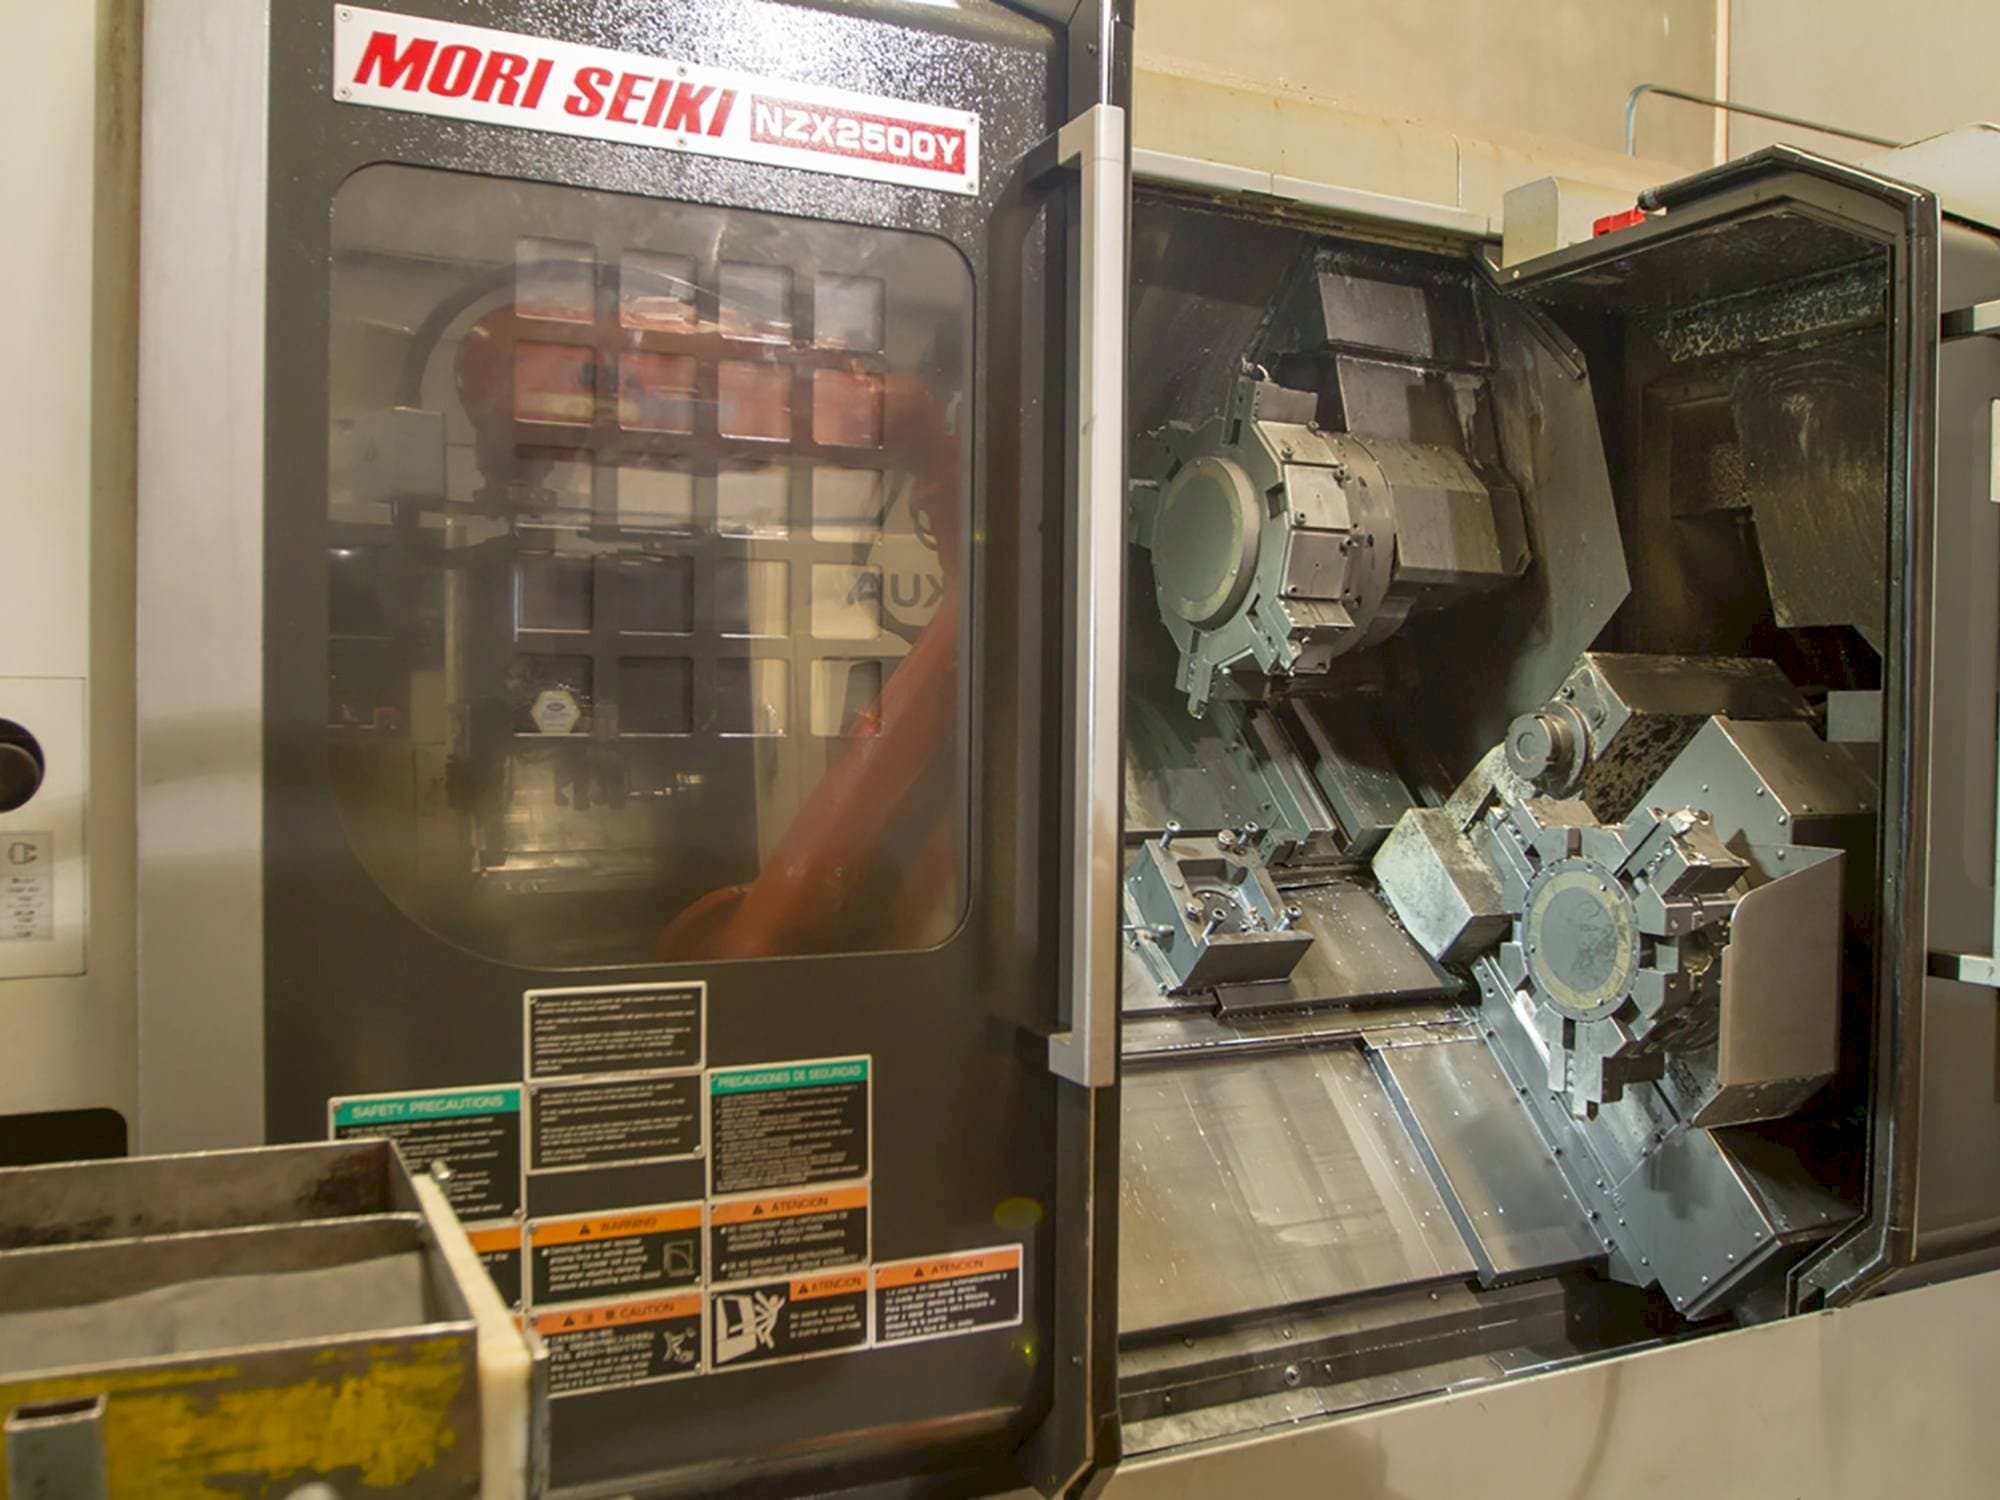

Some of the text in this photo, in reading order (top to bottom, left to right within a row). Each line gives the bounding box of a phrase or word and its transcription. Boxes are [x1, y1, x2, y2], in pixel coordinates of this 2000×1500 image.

[353, 31, 737, 137] MORI SEIKI
[753, 103, 965, 166] NZX2500Y
[718, 1065, 862, 1088] PRECAUCIONES DE SEGURIDAD
[352, 1094, 505, 1119] SAFETY PRECAUTIONS
[621, 1301, 675, 1319] CAUTION
